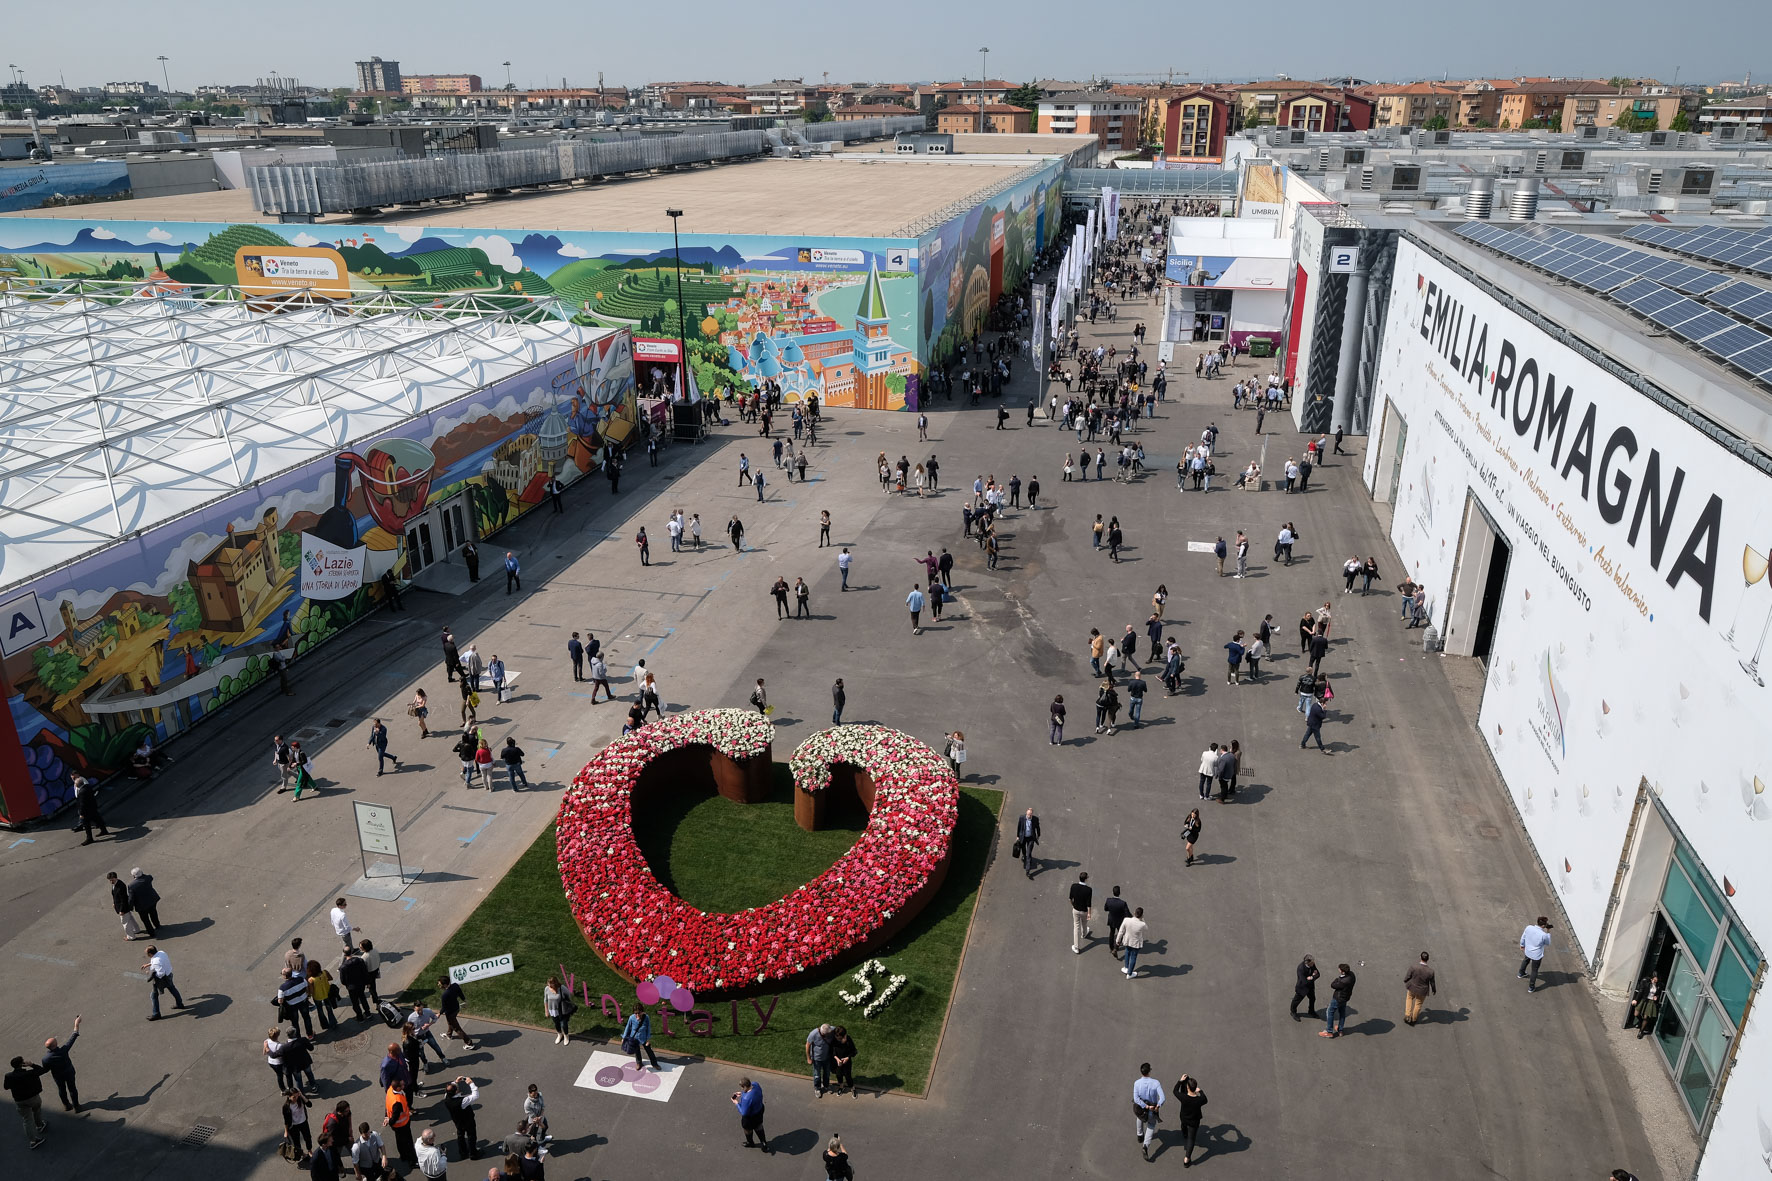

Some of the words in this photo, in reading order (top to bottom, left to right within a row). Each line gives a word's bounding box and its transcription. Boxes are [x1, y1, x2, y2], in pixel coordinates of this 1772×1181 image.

[9, 181, 29, 196] VENEZIA
[28, 174, 45, 188] GIULIA
[1251, 208, 1280, 216] UMBRIA
[892, 254, 904, 266] 4
[1170, 258, 1193, 266] Sicilia
[1336, 254, 1350, 266] 2
[621, 342, 628, 354] A
[1420, 280, 1488, 396] EMILIA
[1490, 338, 1722, 624] ROMAGNA
[1465, 448, 1478, 473] EMILIA
[1507, 502, 1515, 519] UN
[1516, 511, 1539, 545] VIAGGIO
[1539, 540, 1550, 562] NEL
[1552, 555, 1592, 612] BUONGUSTO
[1523, 466, 1550, 507] Malvasia
[1556, 502, 1588, 548] Gutturnio
[1594, 545, 1613, 577] Aceto
[1613, 564, 1648, 618] balsamico
[324, 556, 354, 569] Lazio
[302, 582, 313, 591] UNA
[316, 580, 333, 590] STORIA
[342, 580, 359, 590] SAPORI
[9, 612, 36, 640] A
[469, 957, 510, 972] amia
[560, 963, 779, 1036] vintaly
